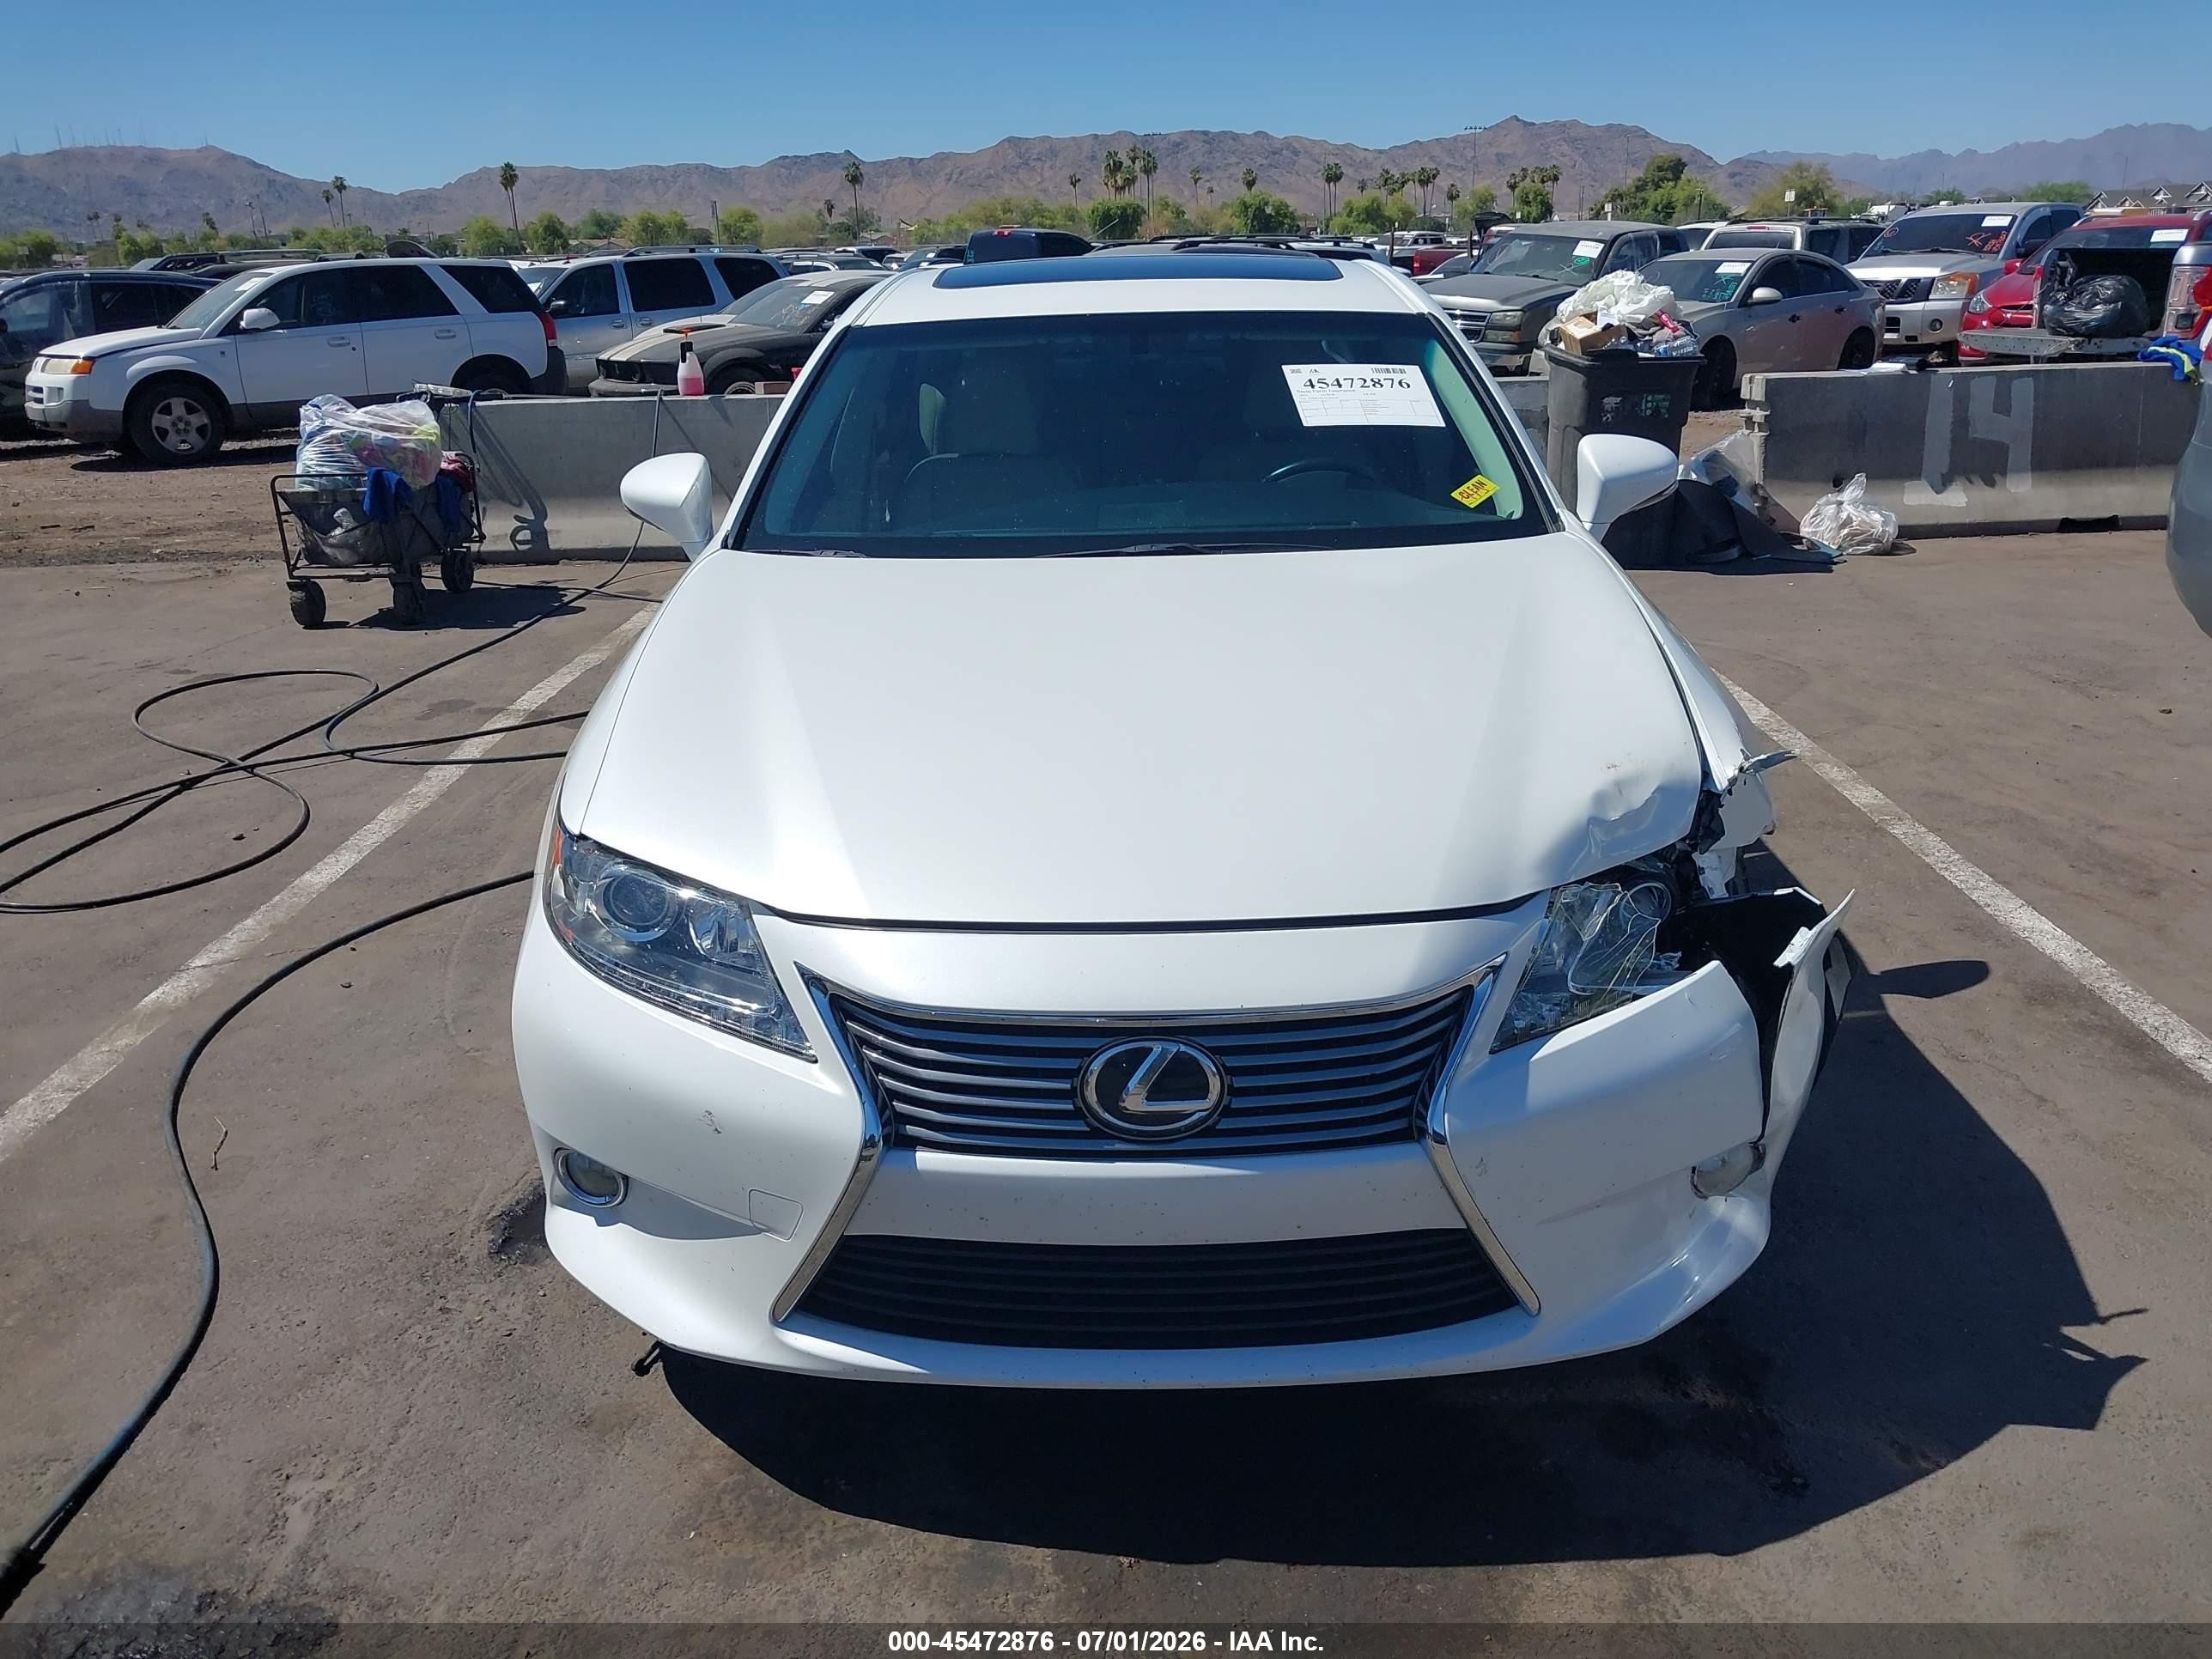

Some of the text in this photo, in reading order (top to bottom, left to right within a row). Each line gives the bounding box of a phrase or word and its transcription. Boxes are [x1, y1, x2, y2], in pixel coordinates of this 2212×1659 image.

[1304, 377, 1411, 389] 45472876
[1904, 374, 2034, 507] 14
[1458, 479, 1487, 500] CLEAN
